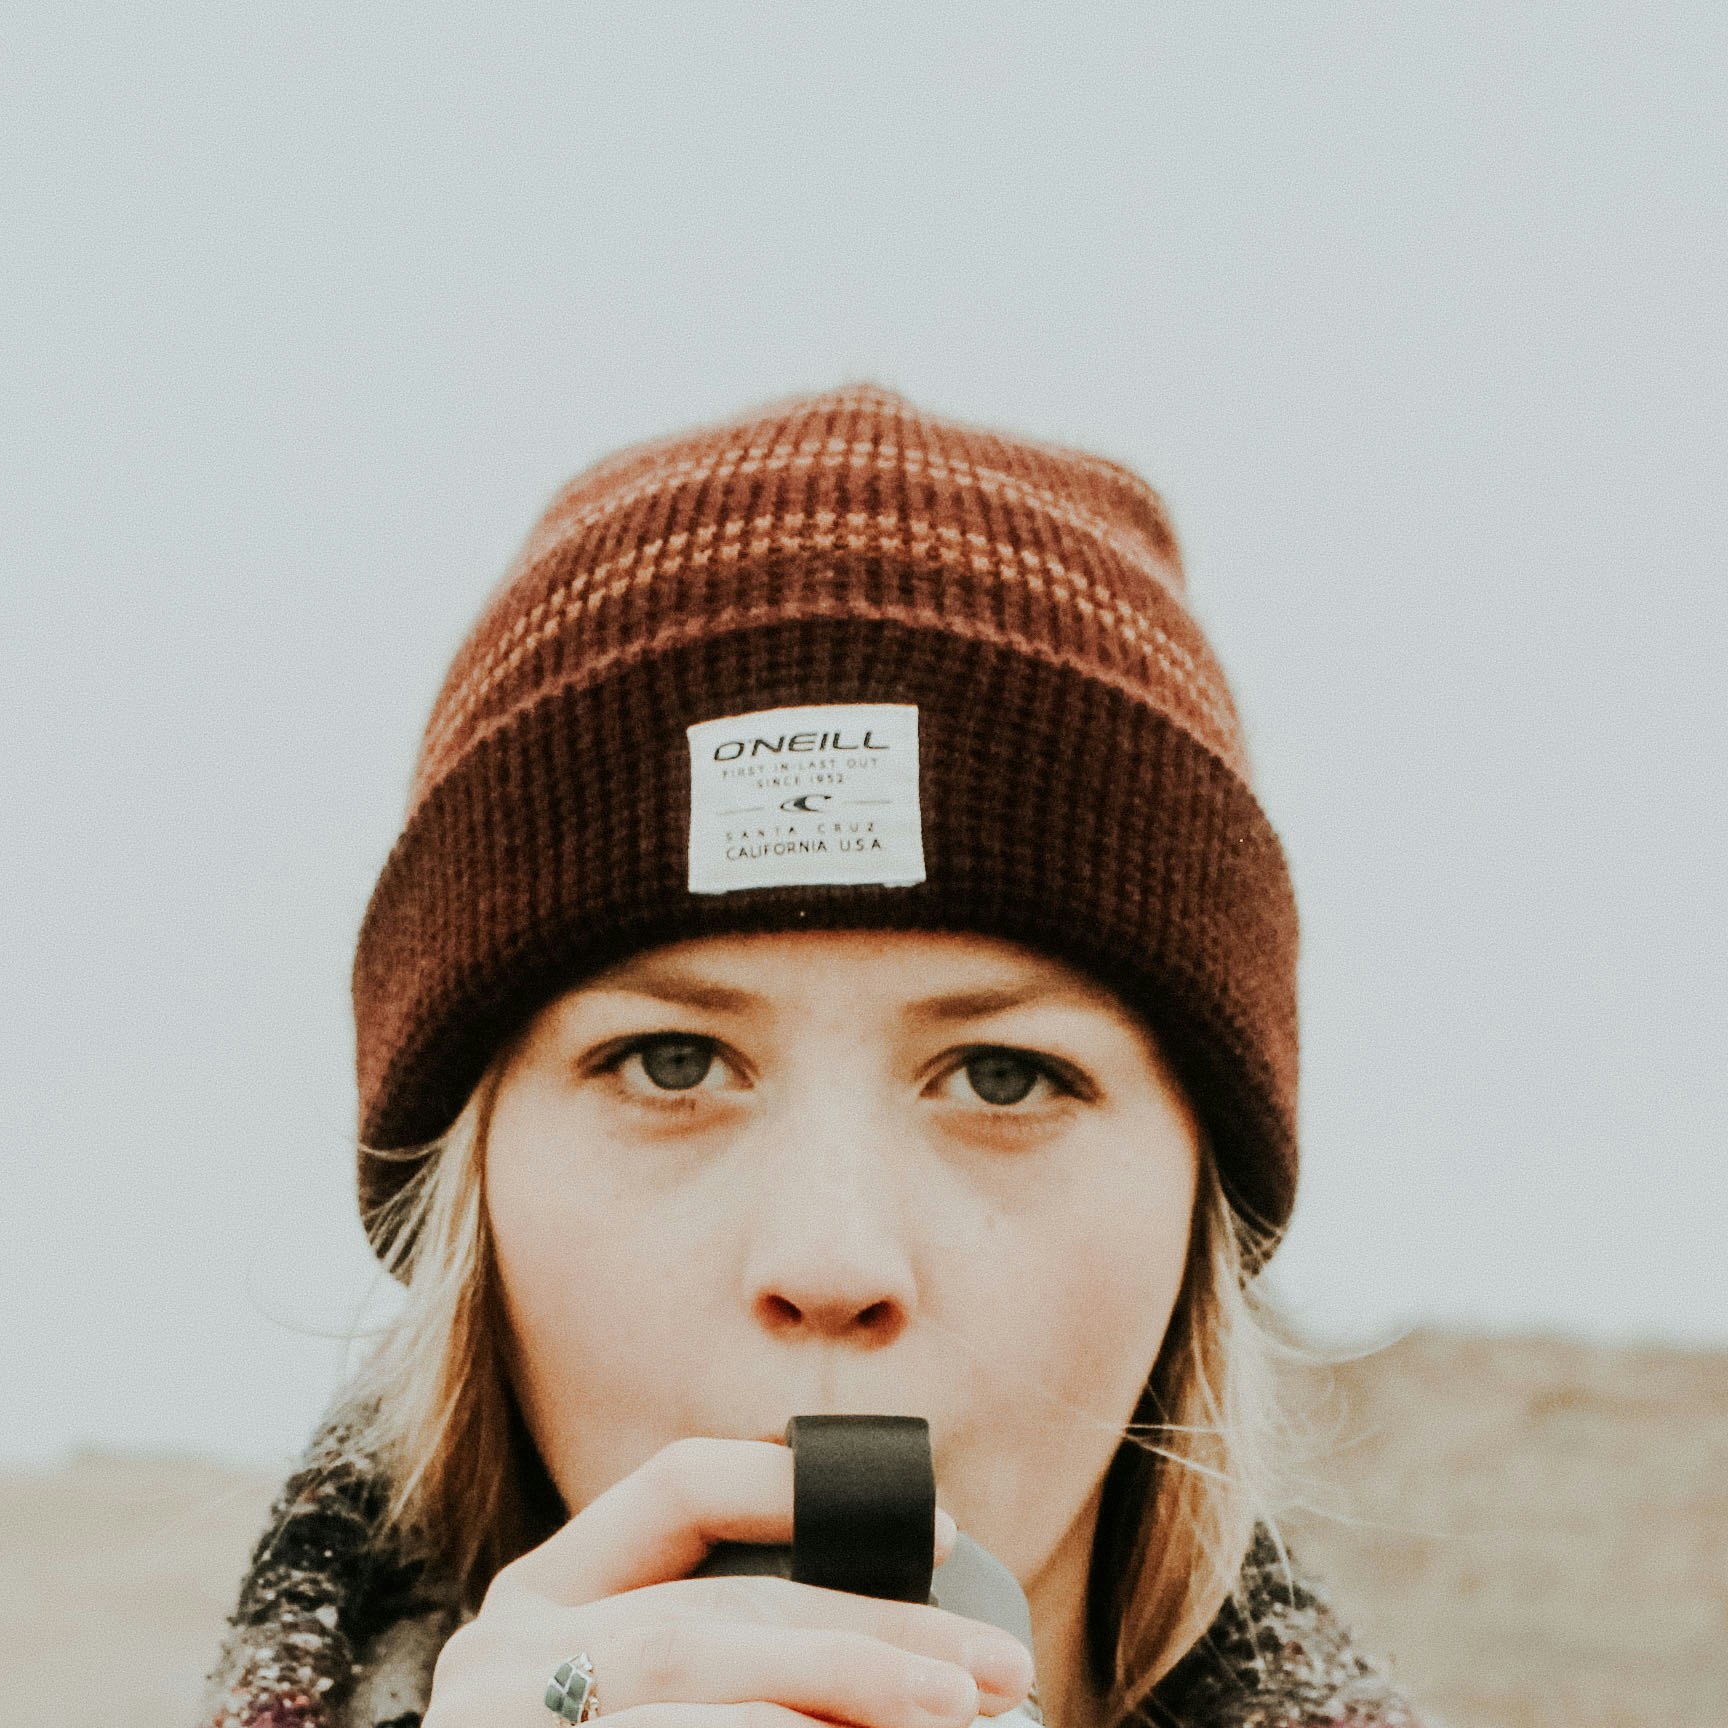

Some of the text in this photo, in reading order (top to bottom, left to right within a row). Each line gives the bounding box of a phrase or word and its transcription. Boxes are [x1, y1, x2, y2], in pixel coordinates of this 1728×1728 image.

[722, 757, 879, 780] FIRST IN LAST OUT
[755, 773, 845, 788] SINCE 1952
[725, 821, 875, 841] SANTA CRUZ
[726, 839, 828, 861] CALIFORNIA
